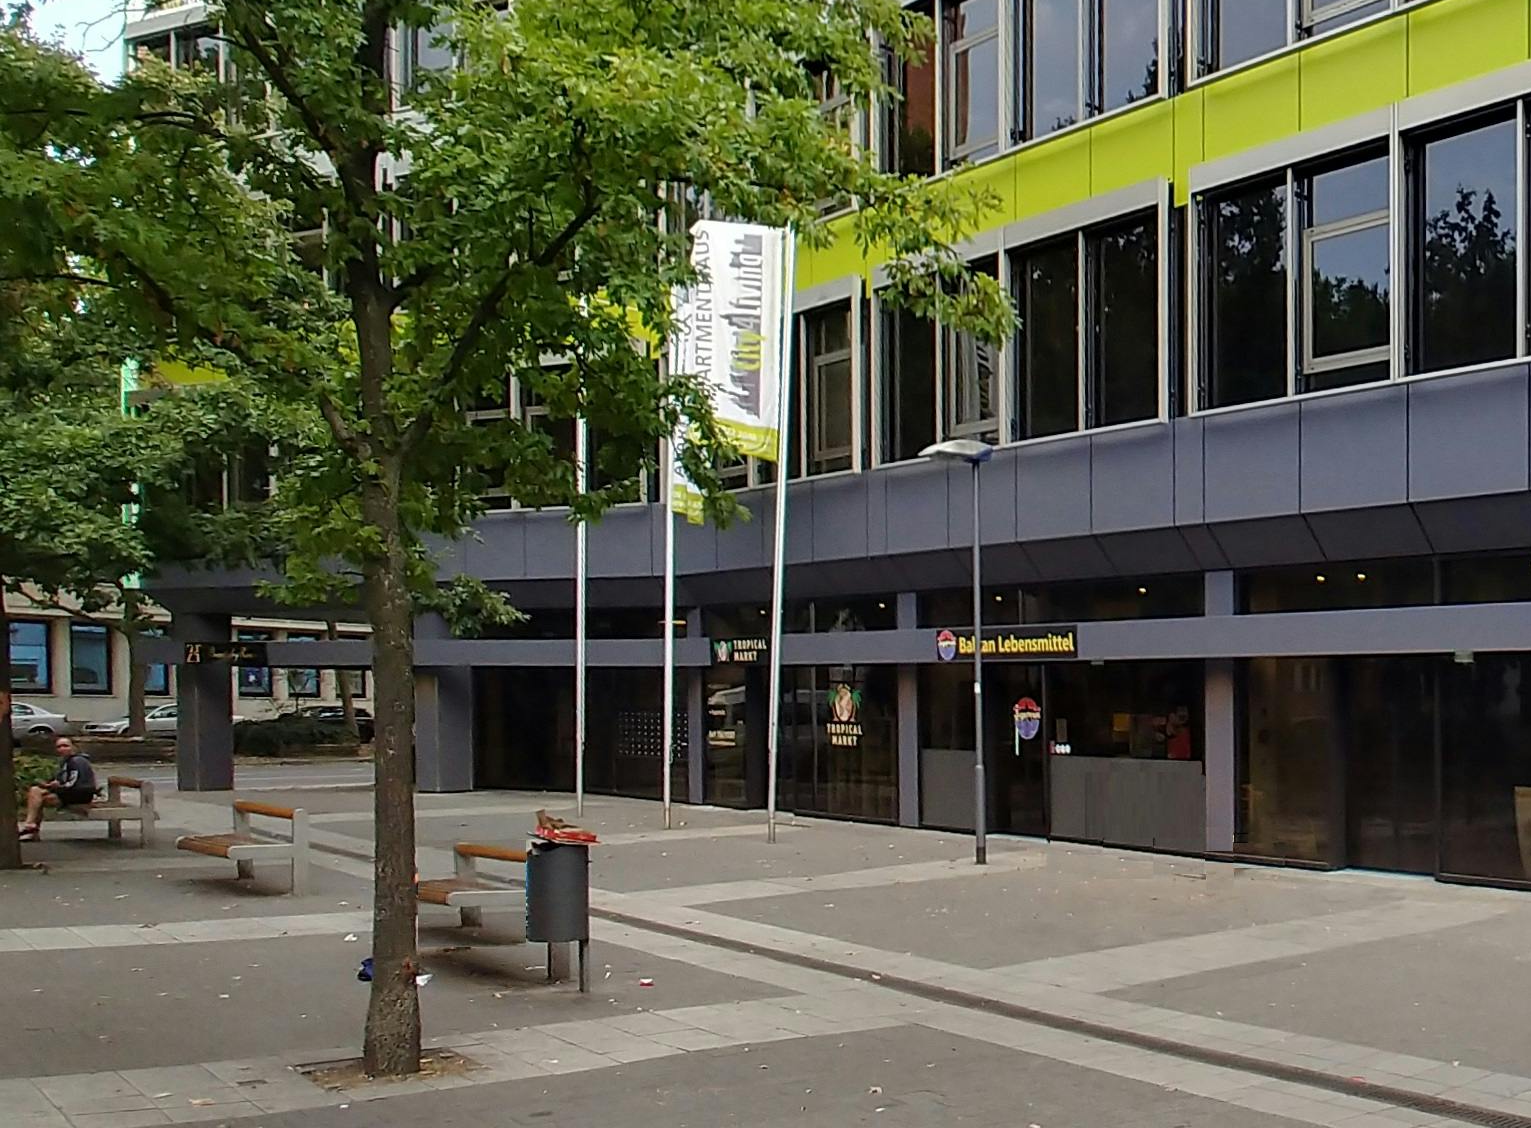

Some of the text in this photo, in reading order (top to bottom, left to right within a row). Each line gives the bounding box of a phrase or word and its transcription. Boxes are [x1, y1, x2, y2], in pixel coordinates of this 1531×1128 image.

[733, 638, 767, 651] TROPICAL
[958, 632, 1075, 654] Balan Lebensmittel
[733, 651, 758, 662] MARKT
[827, 723, 863, 736] TROPICAL
[831, 735, 858, 747] MARKT
